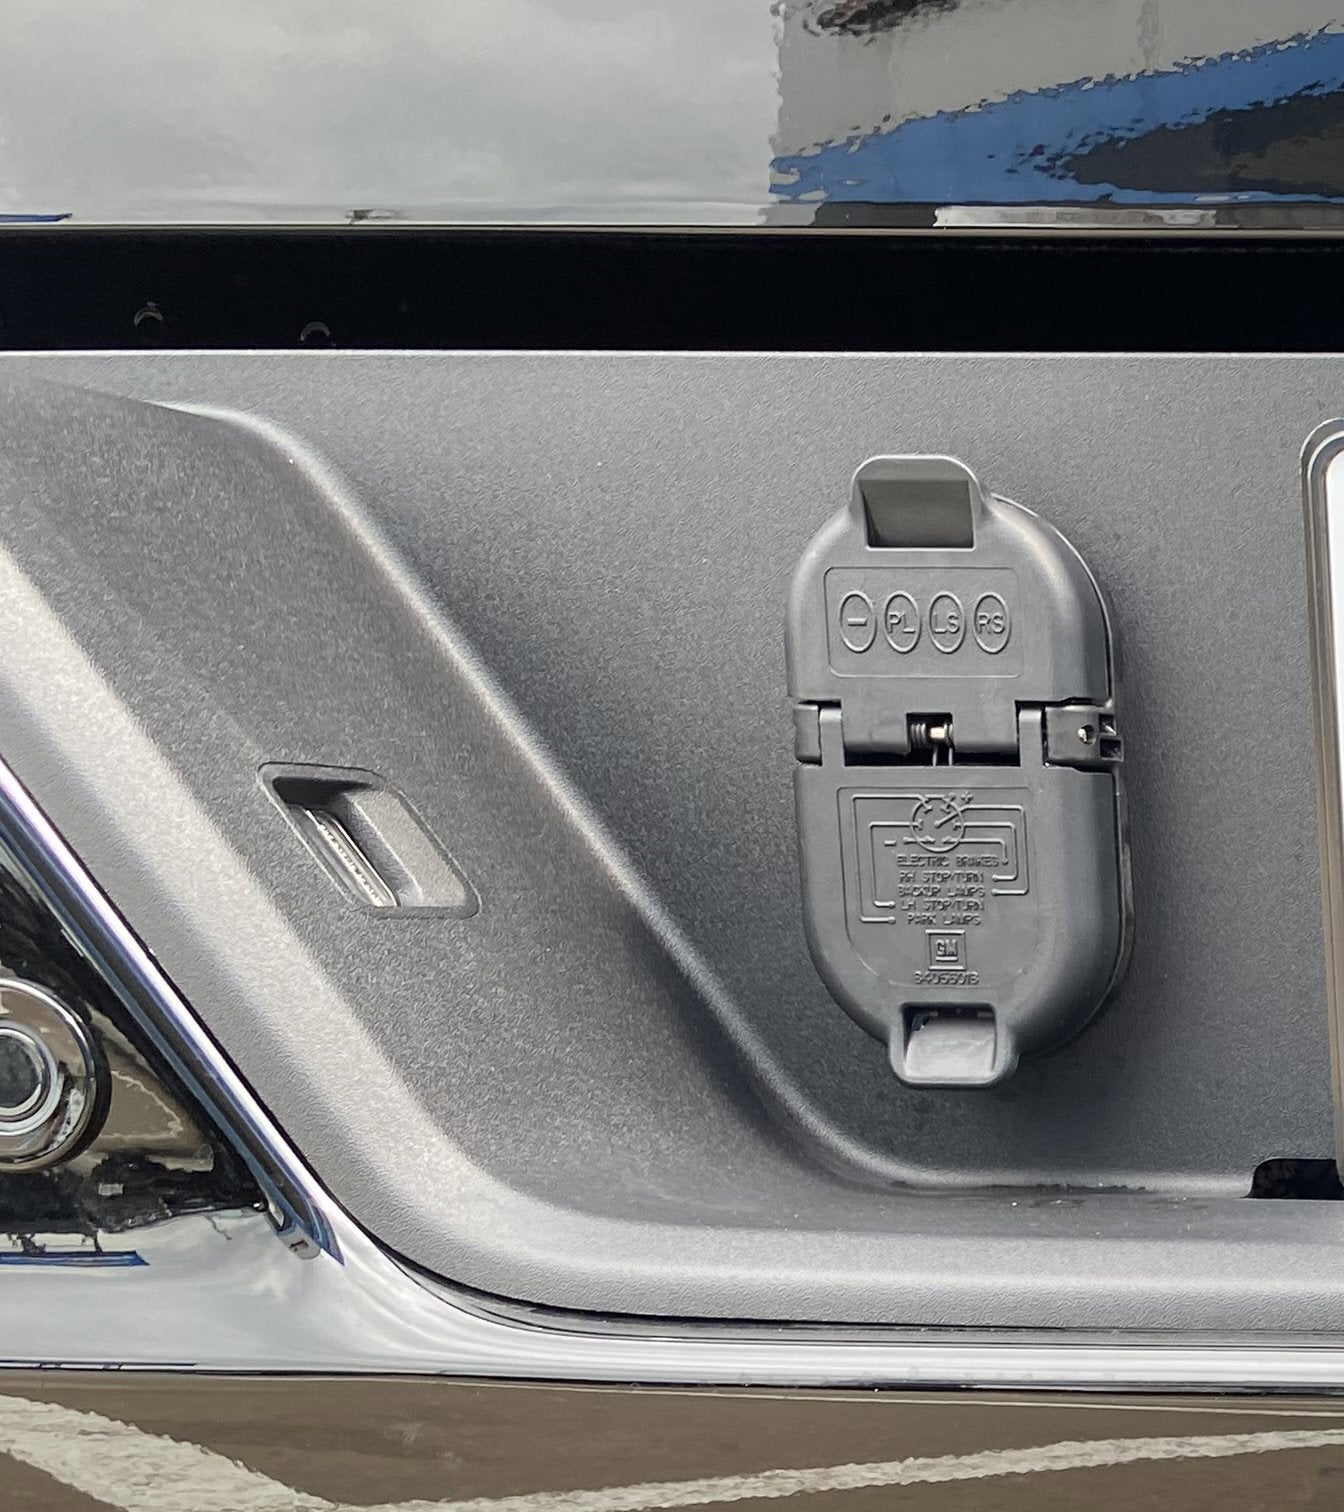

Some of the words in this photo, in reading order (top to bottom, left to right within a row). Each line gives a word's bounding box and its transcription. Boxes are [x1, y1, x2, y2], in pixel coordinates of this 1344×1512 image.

[887, 611, 916, 634] PL
[932, 612, 961, 635] LS
[976, 612, 1005, 635] RS
[935, 938, 958, 962] GM
